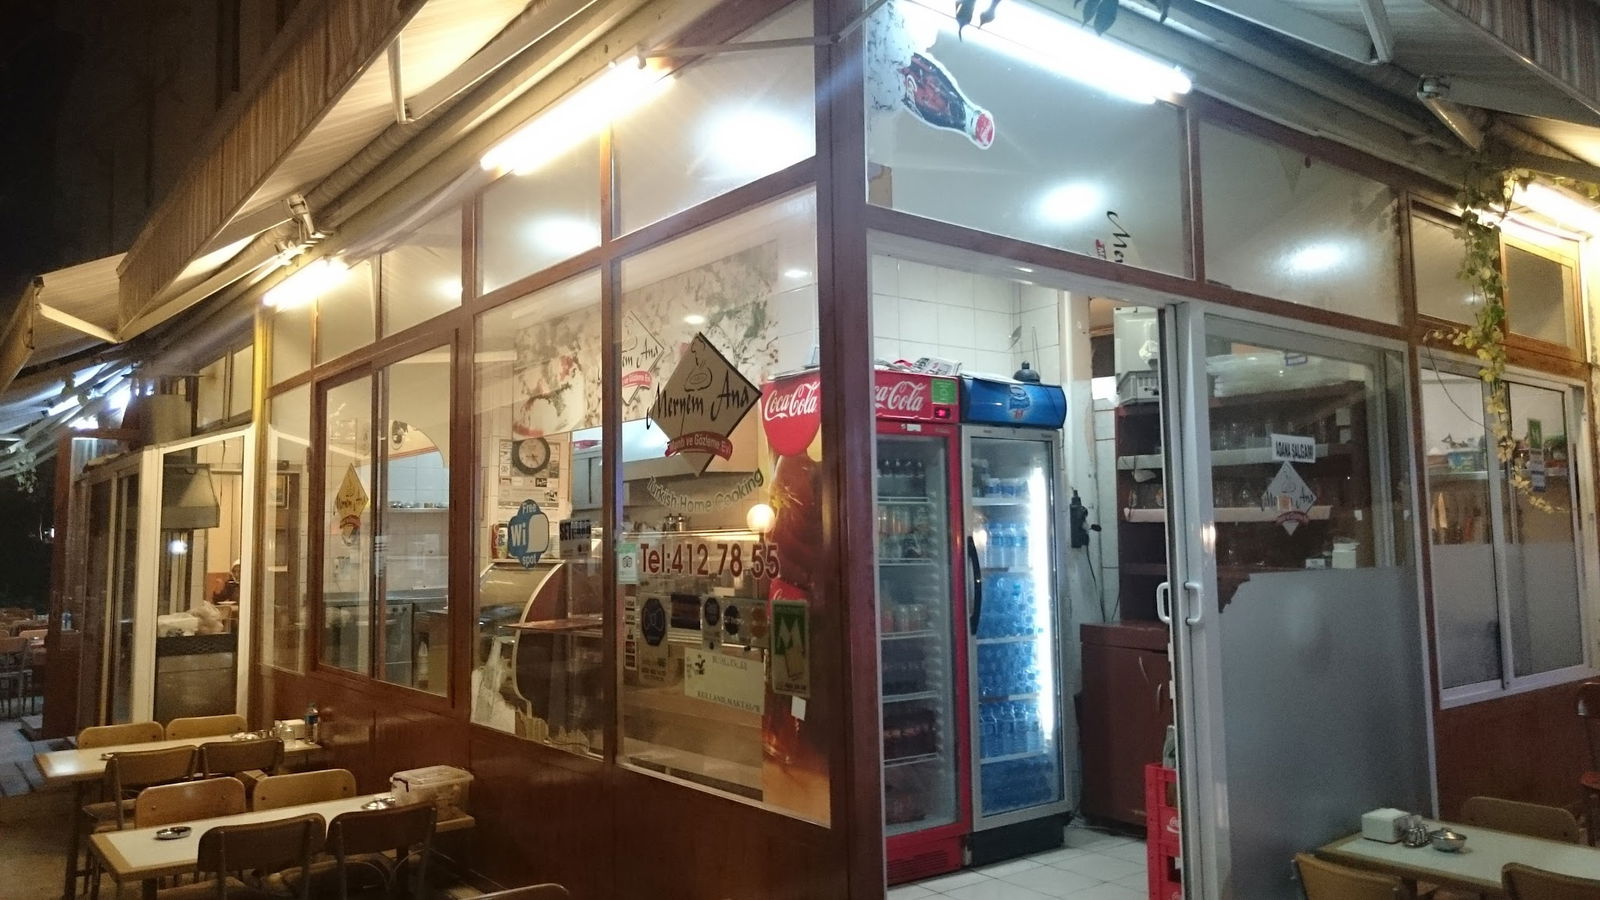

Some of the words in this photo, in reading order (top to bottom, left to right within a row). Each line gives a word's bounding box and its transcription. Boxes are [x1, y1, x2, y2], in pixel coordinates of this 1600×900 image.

[646, 382, 704, 438] Meryem
[710, 371, 749, 421] Ana
[764, 382, 820, 421] Coca-Cola
[522, 503, 537, 515] Free
[646, 476, 677, 507] Turkish
[680, 495, 712, 514] Home
[715, 468, 764, 508] Cooking
[522, 554, 537, 568] spot
[717, 543, 743, 578] 78
[751, 545, 780, 580] 55
